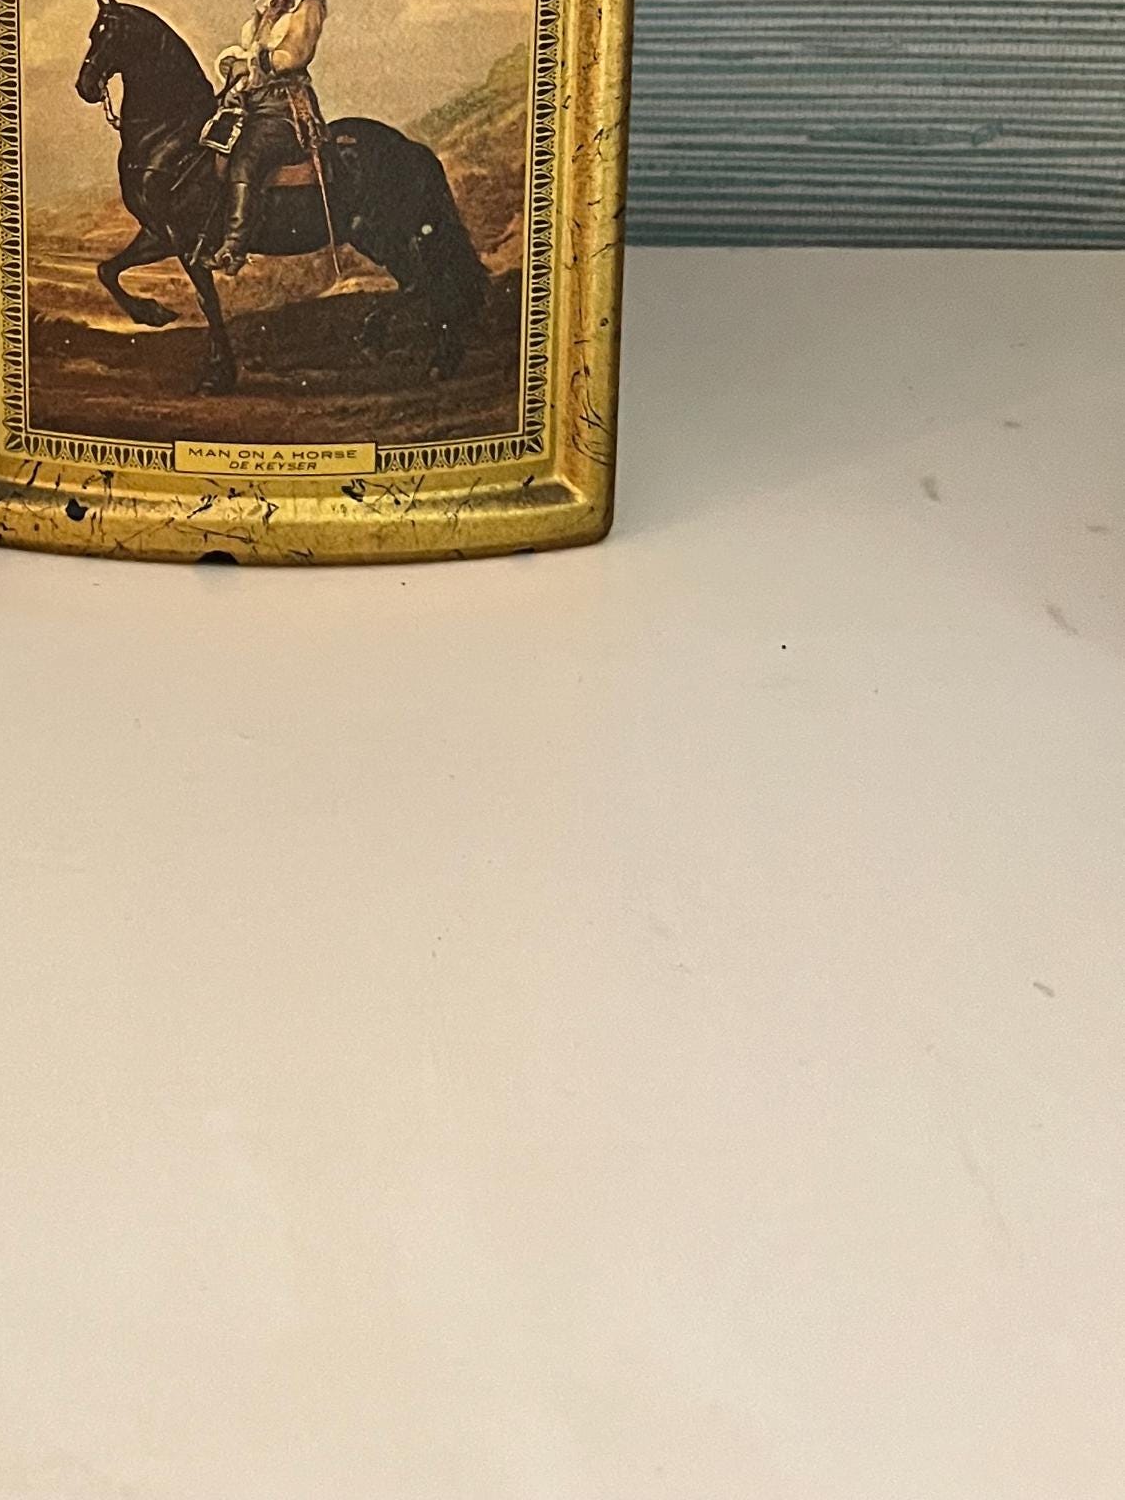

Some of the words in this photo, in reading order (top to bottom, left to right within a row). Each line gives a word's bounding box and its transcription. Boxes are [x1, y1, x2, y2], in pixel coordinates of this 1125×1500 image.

[188, 447, 231, 459] MAN
[238, 450, 265, 460] ON
[274, 451, 285, 460] A
[292, 449, 358, 460] HORSE
[229, 461, 249, 470] DE
[254, 461, 318, 471] KEYSER
